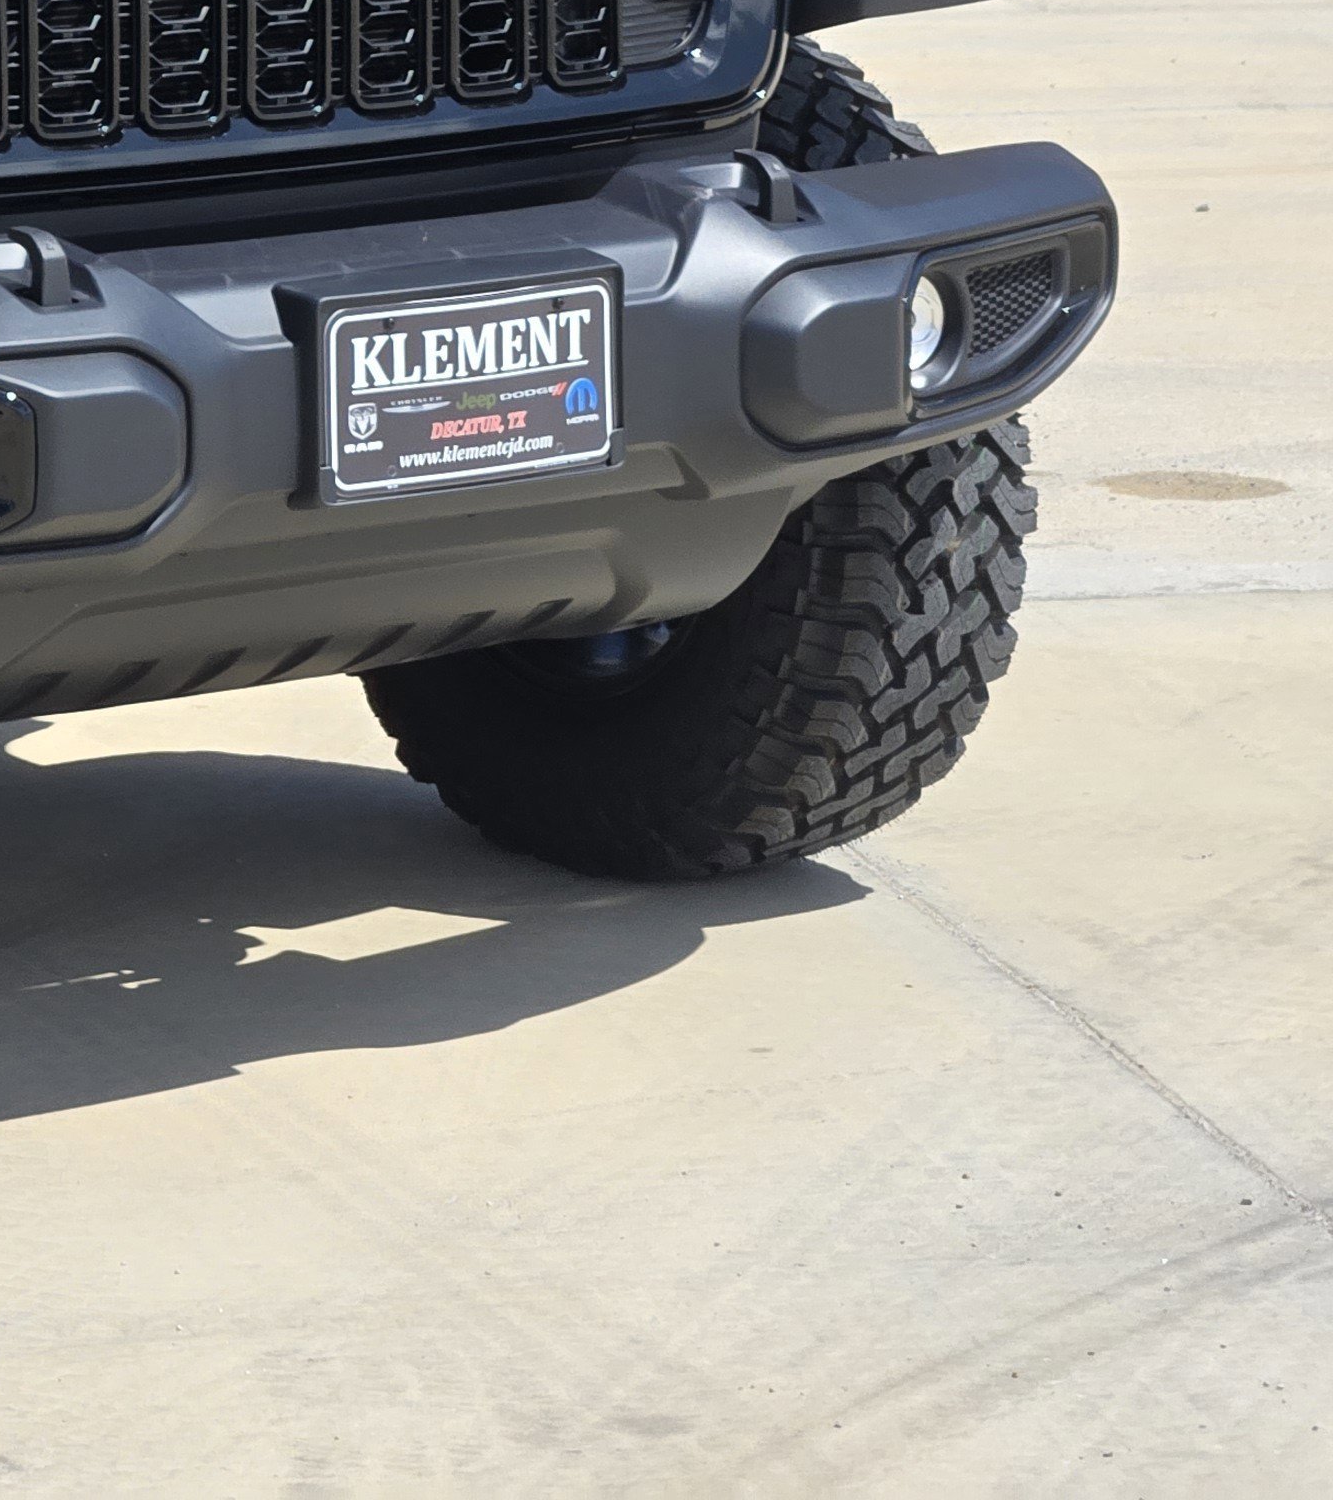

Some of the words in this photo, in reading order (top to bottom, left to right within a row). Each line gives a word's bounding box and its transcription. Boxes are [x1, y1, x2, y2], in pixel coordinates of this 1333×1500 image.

[351, 309, 591, 389] KLEMENT
[455, 391, 497, 411] Jeep
[499, 384, 557, 402] DODGE
[430, 413, 504, 440] DECATUR,
[507, 410, 528, 429] TX
[344, 441, 383, 454] RAM
[399, 434, 554, 469] www.klementcjd.com
